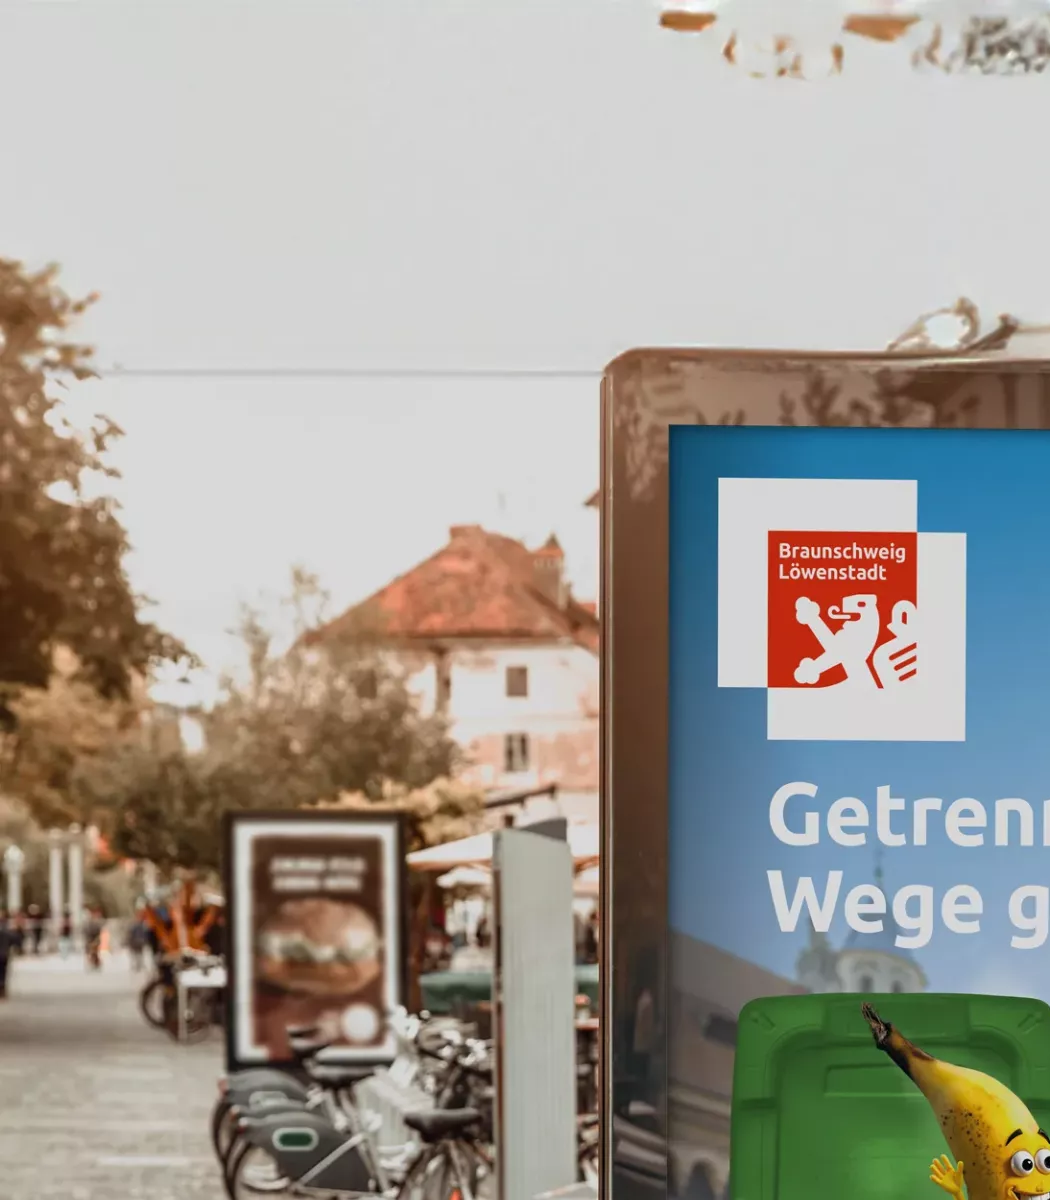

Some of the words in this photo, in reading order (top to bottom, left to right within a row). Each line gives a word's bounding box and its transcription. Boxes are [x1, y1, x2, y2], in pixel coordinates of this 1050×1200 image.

[779, 542, 906, 564] Braunschweig
[779, 563, 887, 580] Löwenstadt
[766, 870, 984, 949] Wege
